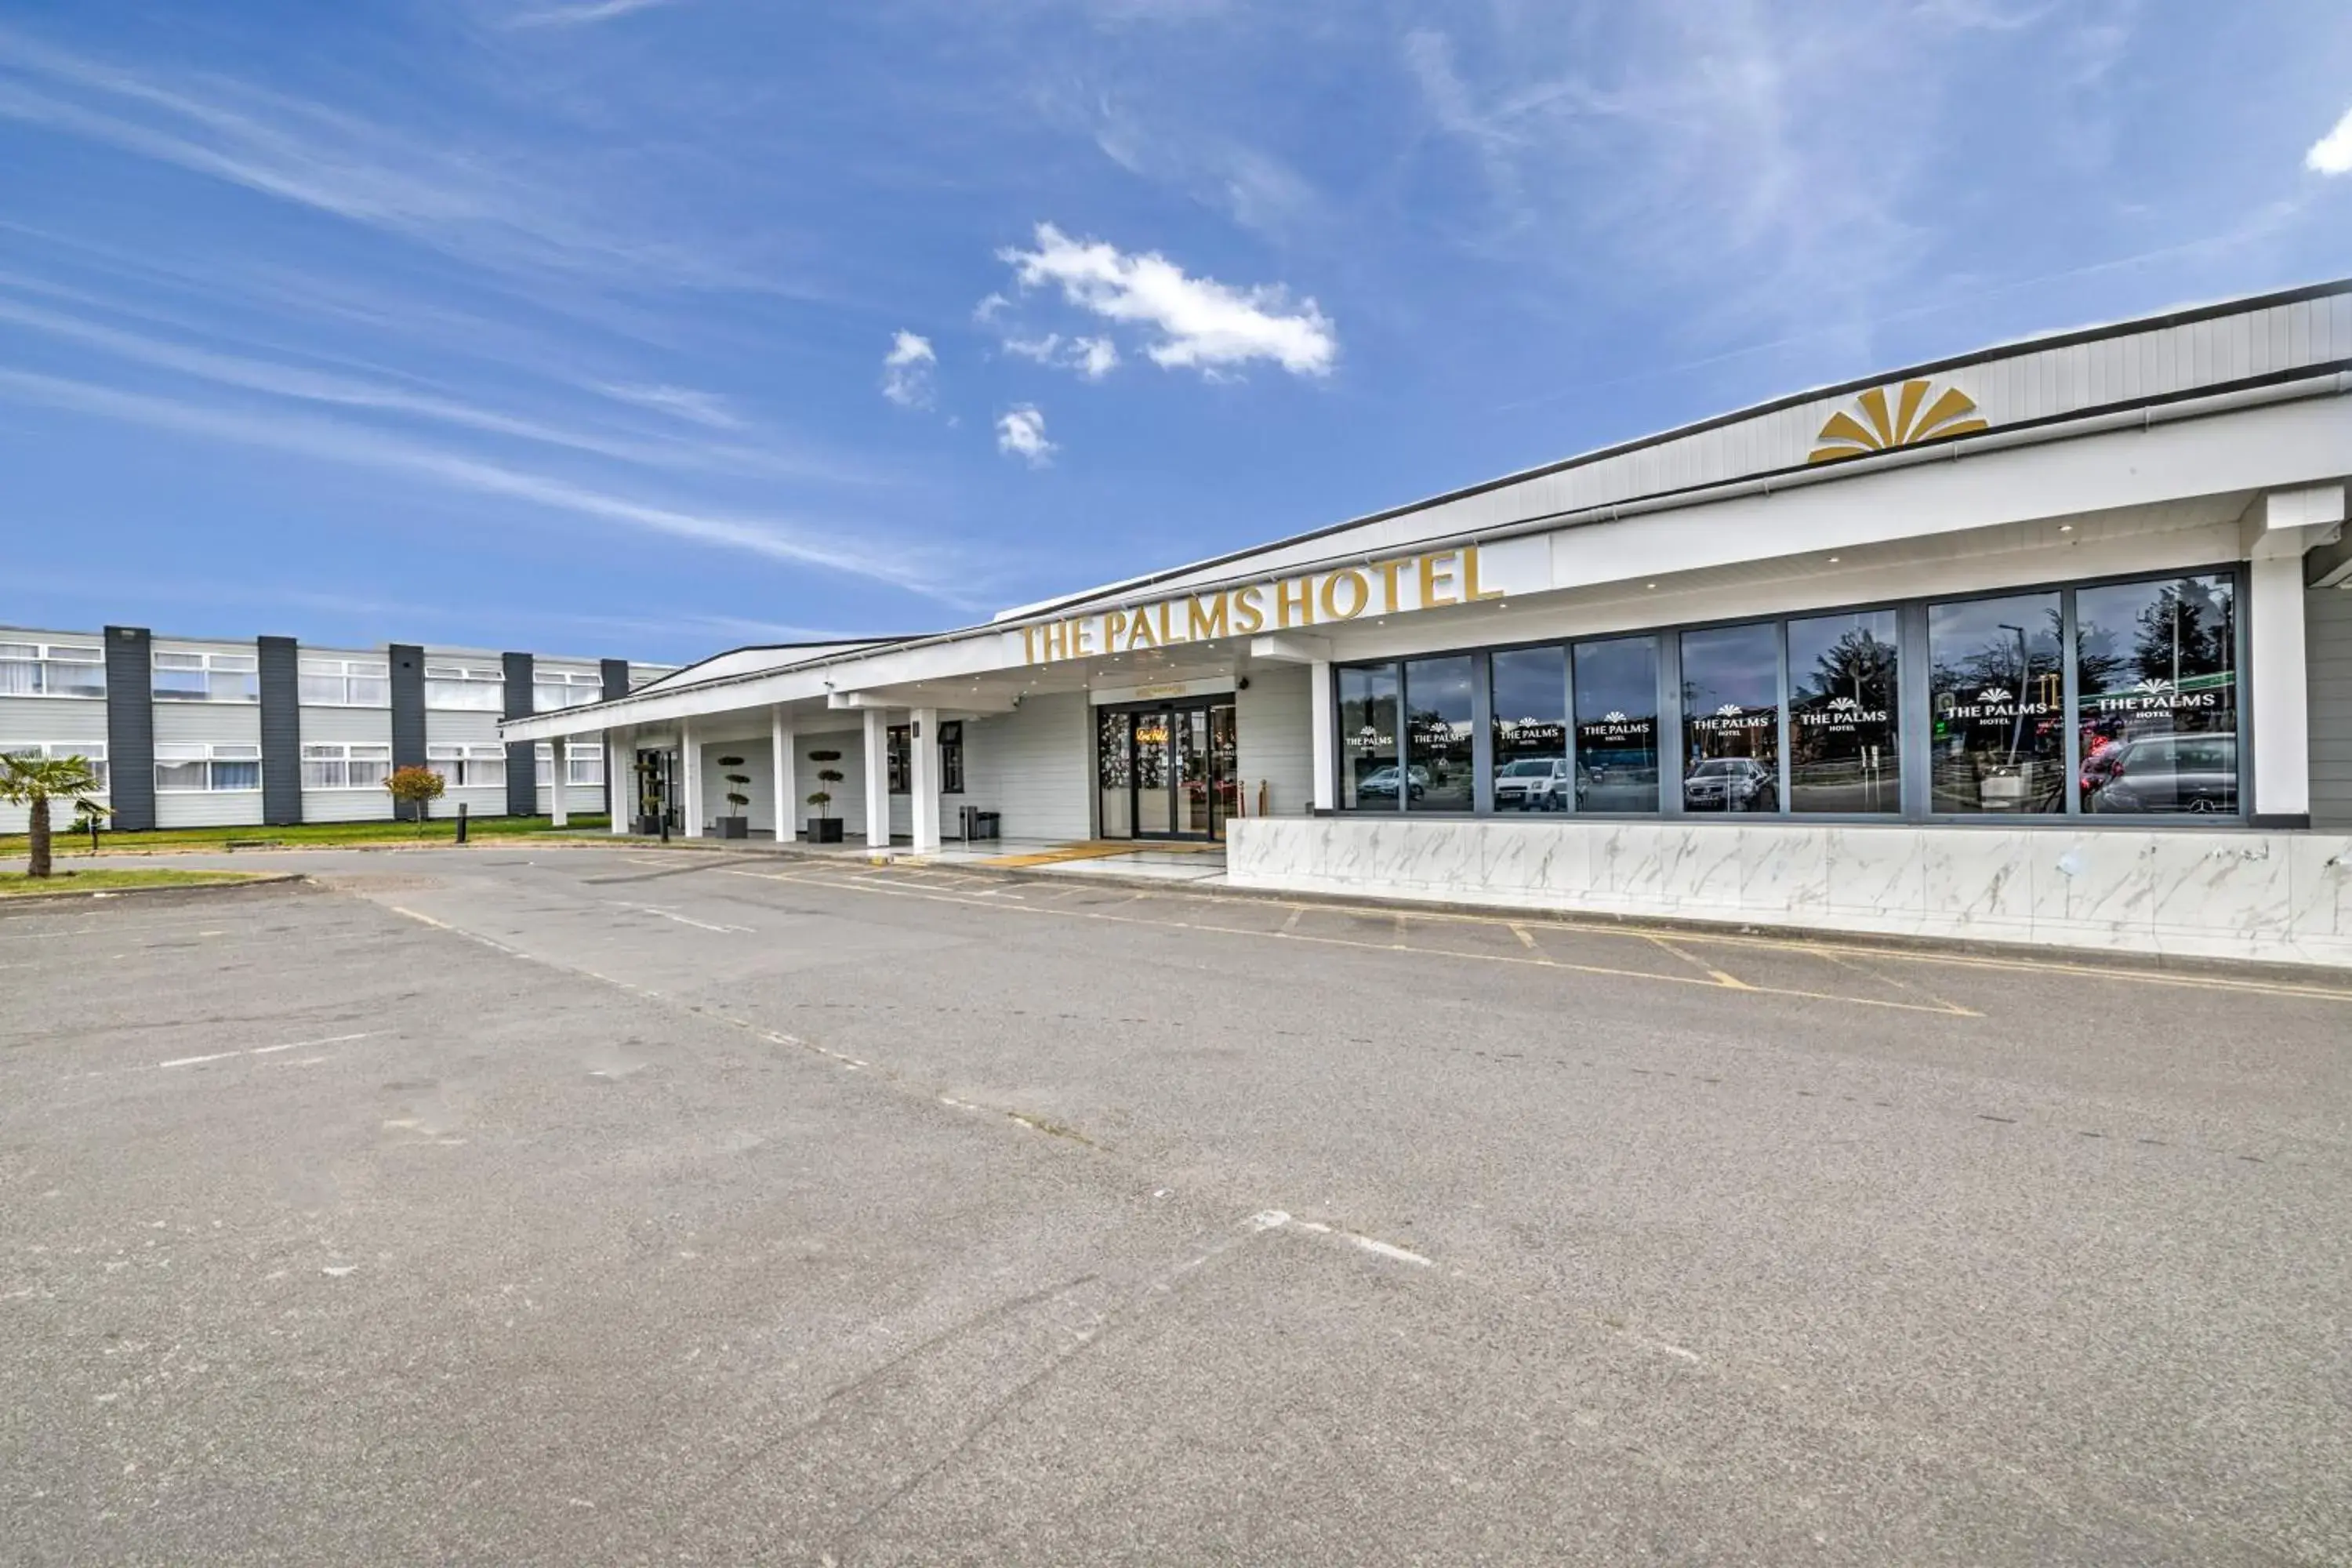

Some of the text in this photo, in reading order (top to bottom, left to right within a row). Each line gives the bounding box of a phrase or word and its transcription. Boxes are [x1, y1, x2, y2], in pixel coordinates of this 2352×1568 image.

[1022, 546, 1504, 665] THE PALMS HOTEL
[2100, 694, 2216, 710] THE PALMS
[1800, 710, 1887, 725] THE PALMS
[1948, 702, 2048, 719] THE PALMS
[1584, 724, 1650, 735] THE PALMS
[1693, 717, 1769, 730] THE PALMS
[1500, 728, 1559, 739] THE PALMS
